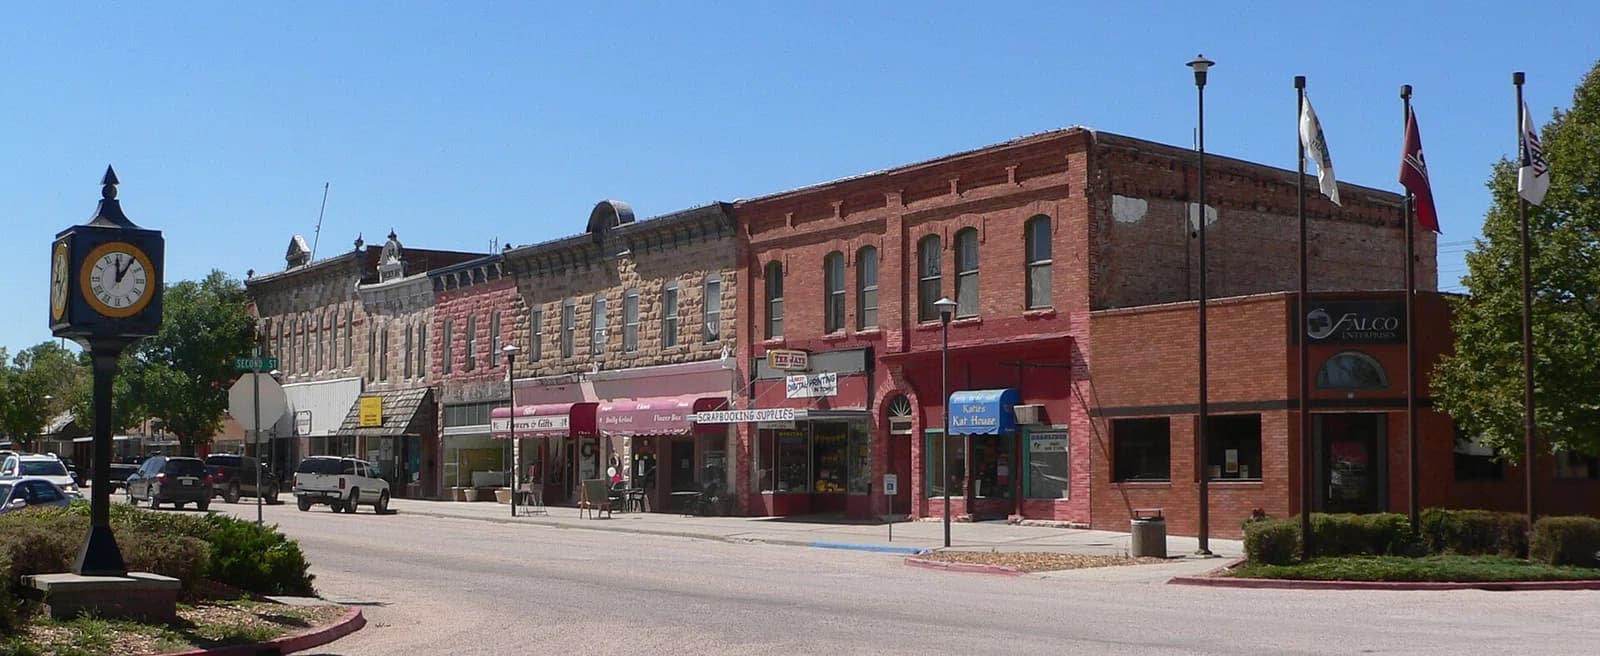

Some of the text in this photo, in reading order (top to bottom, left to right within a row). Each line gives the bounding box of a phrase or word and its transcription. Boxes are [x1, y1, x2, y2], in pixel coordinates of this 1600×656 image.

[1334, 312, 1399, 331] FALCO
[236, 359, 277, 369] SECOND ST
[809, 374, 836, 388] PRINTING
[698, 408, 794, 423] SCRAPBOOKING SUPPLIES
[953, 415, 997, 426] Kat House
[506, 420, 530, 430] Fowers
